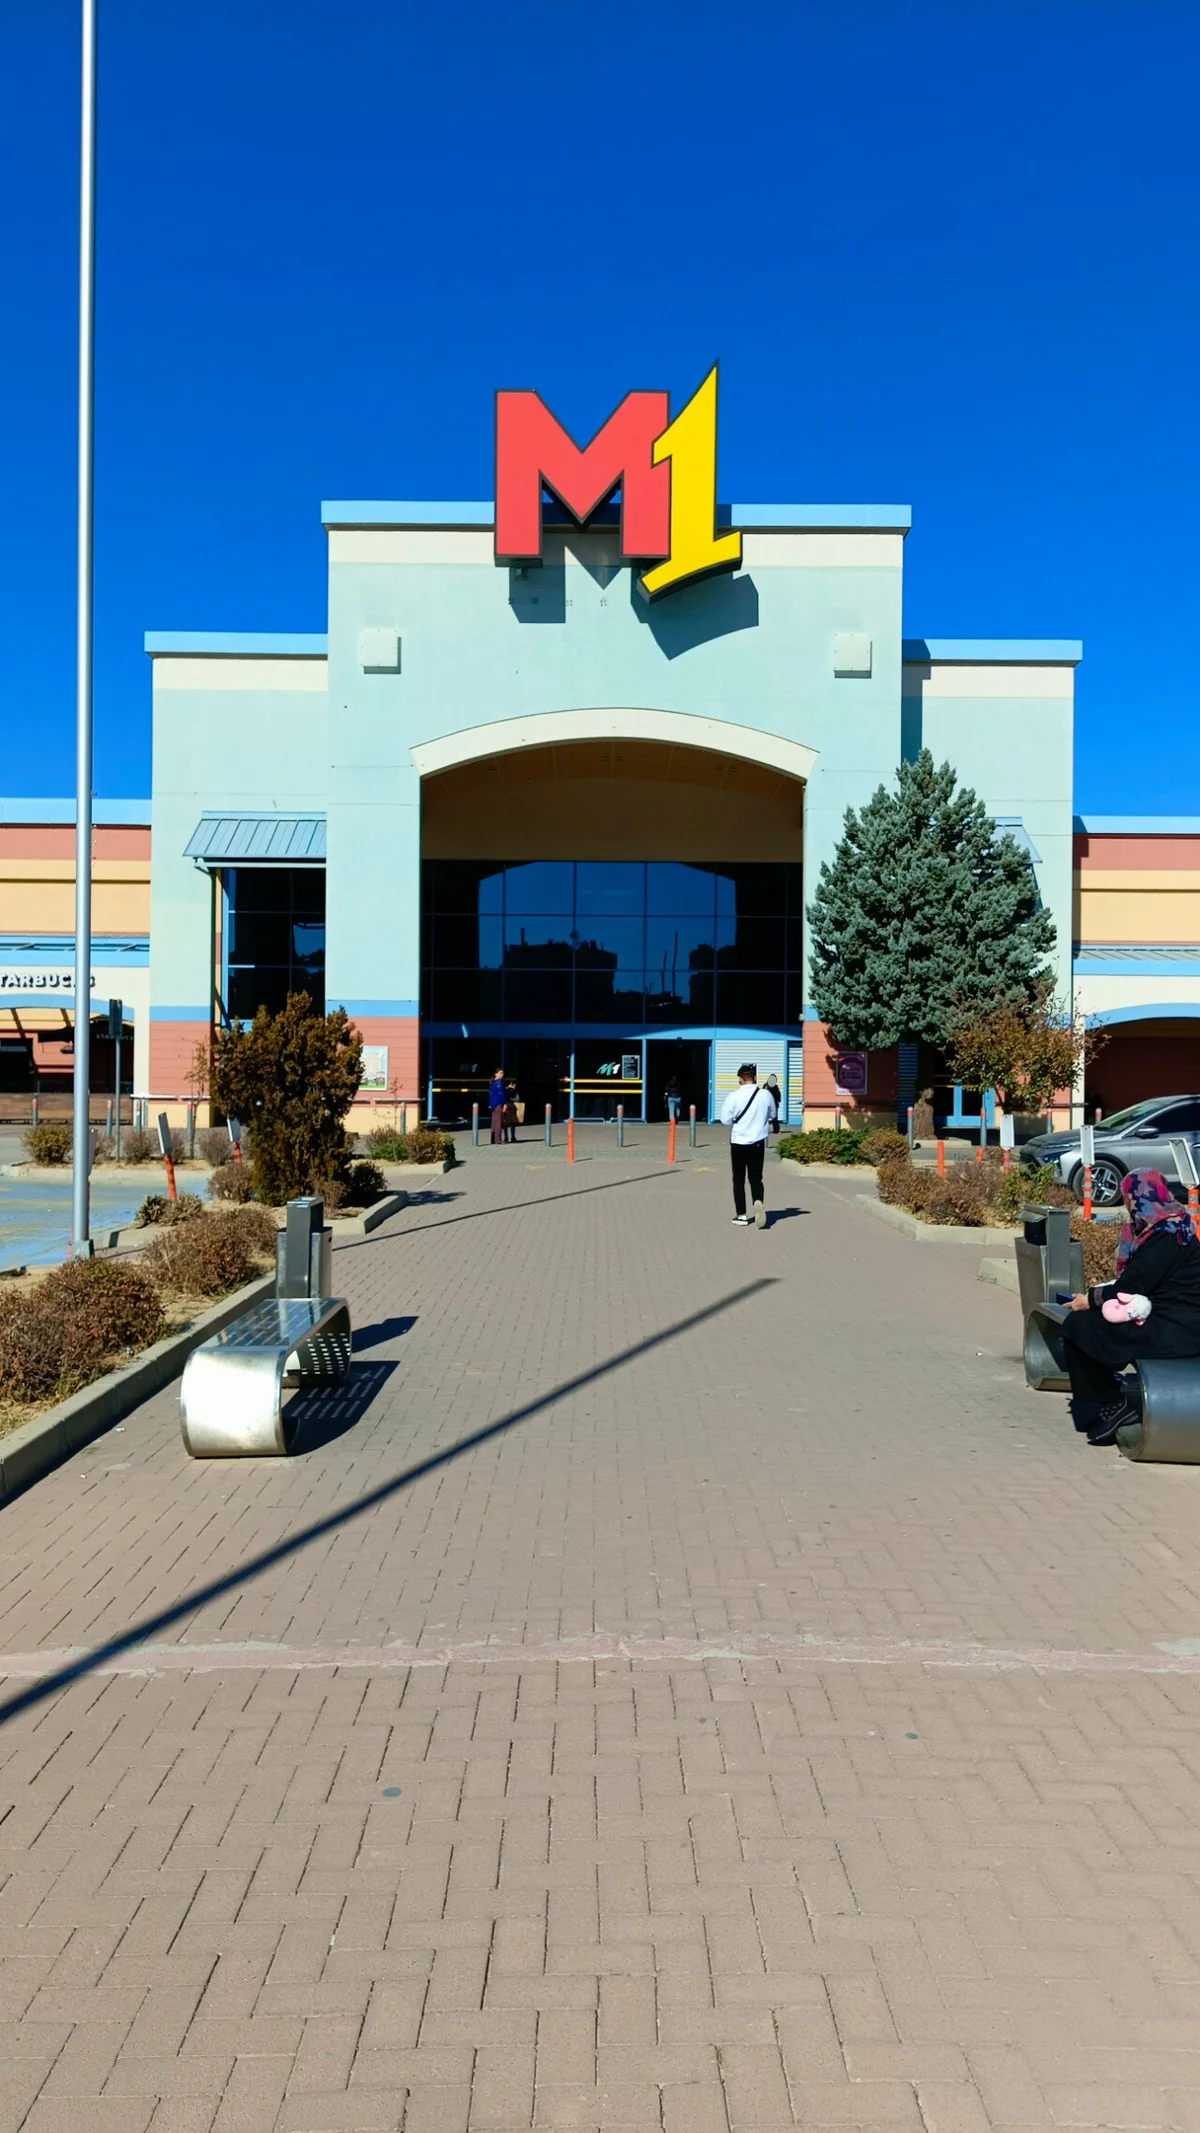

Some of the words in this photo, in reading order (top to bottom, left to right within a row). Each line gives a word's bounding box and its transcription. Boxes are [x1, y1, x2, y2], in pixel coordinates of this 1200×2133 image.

[494, 358, 742, 602] M1
[0, 973, 96, 988] TARBUCS
[596, 1061, 621, 1076] M1
